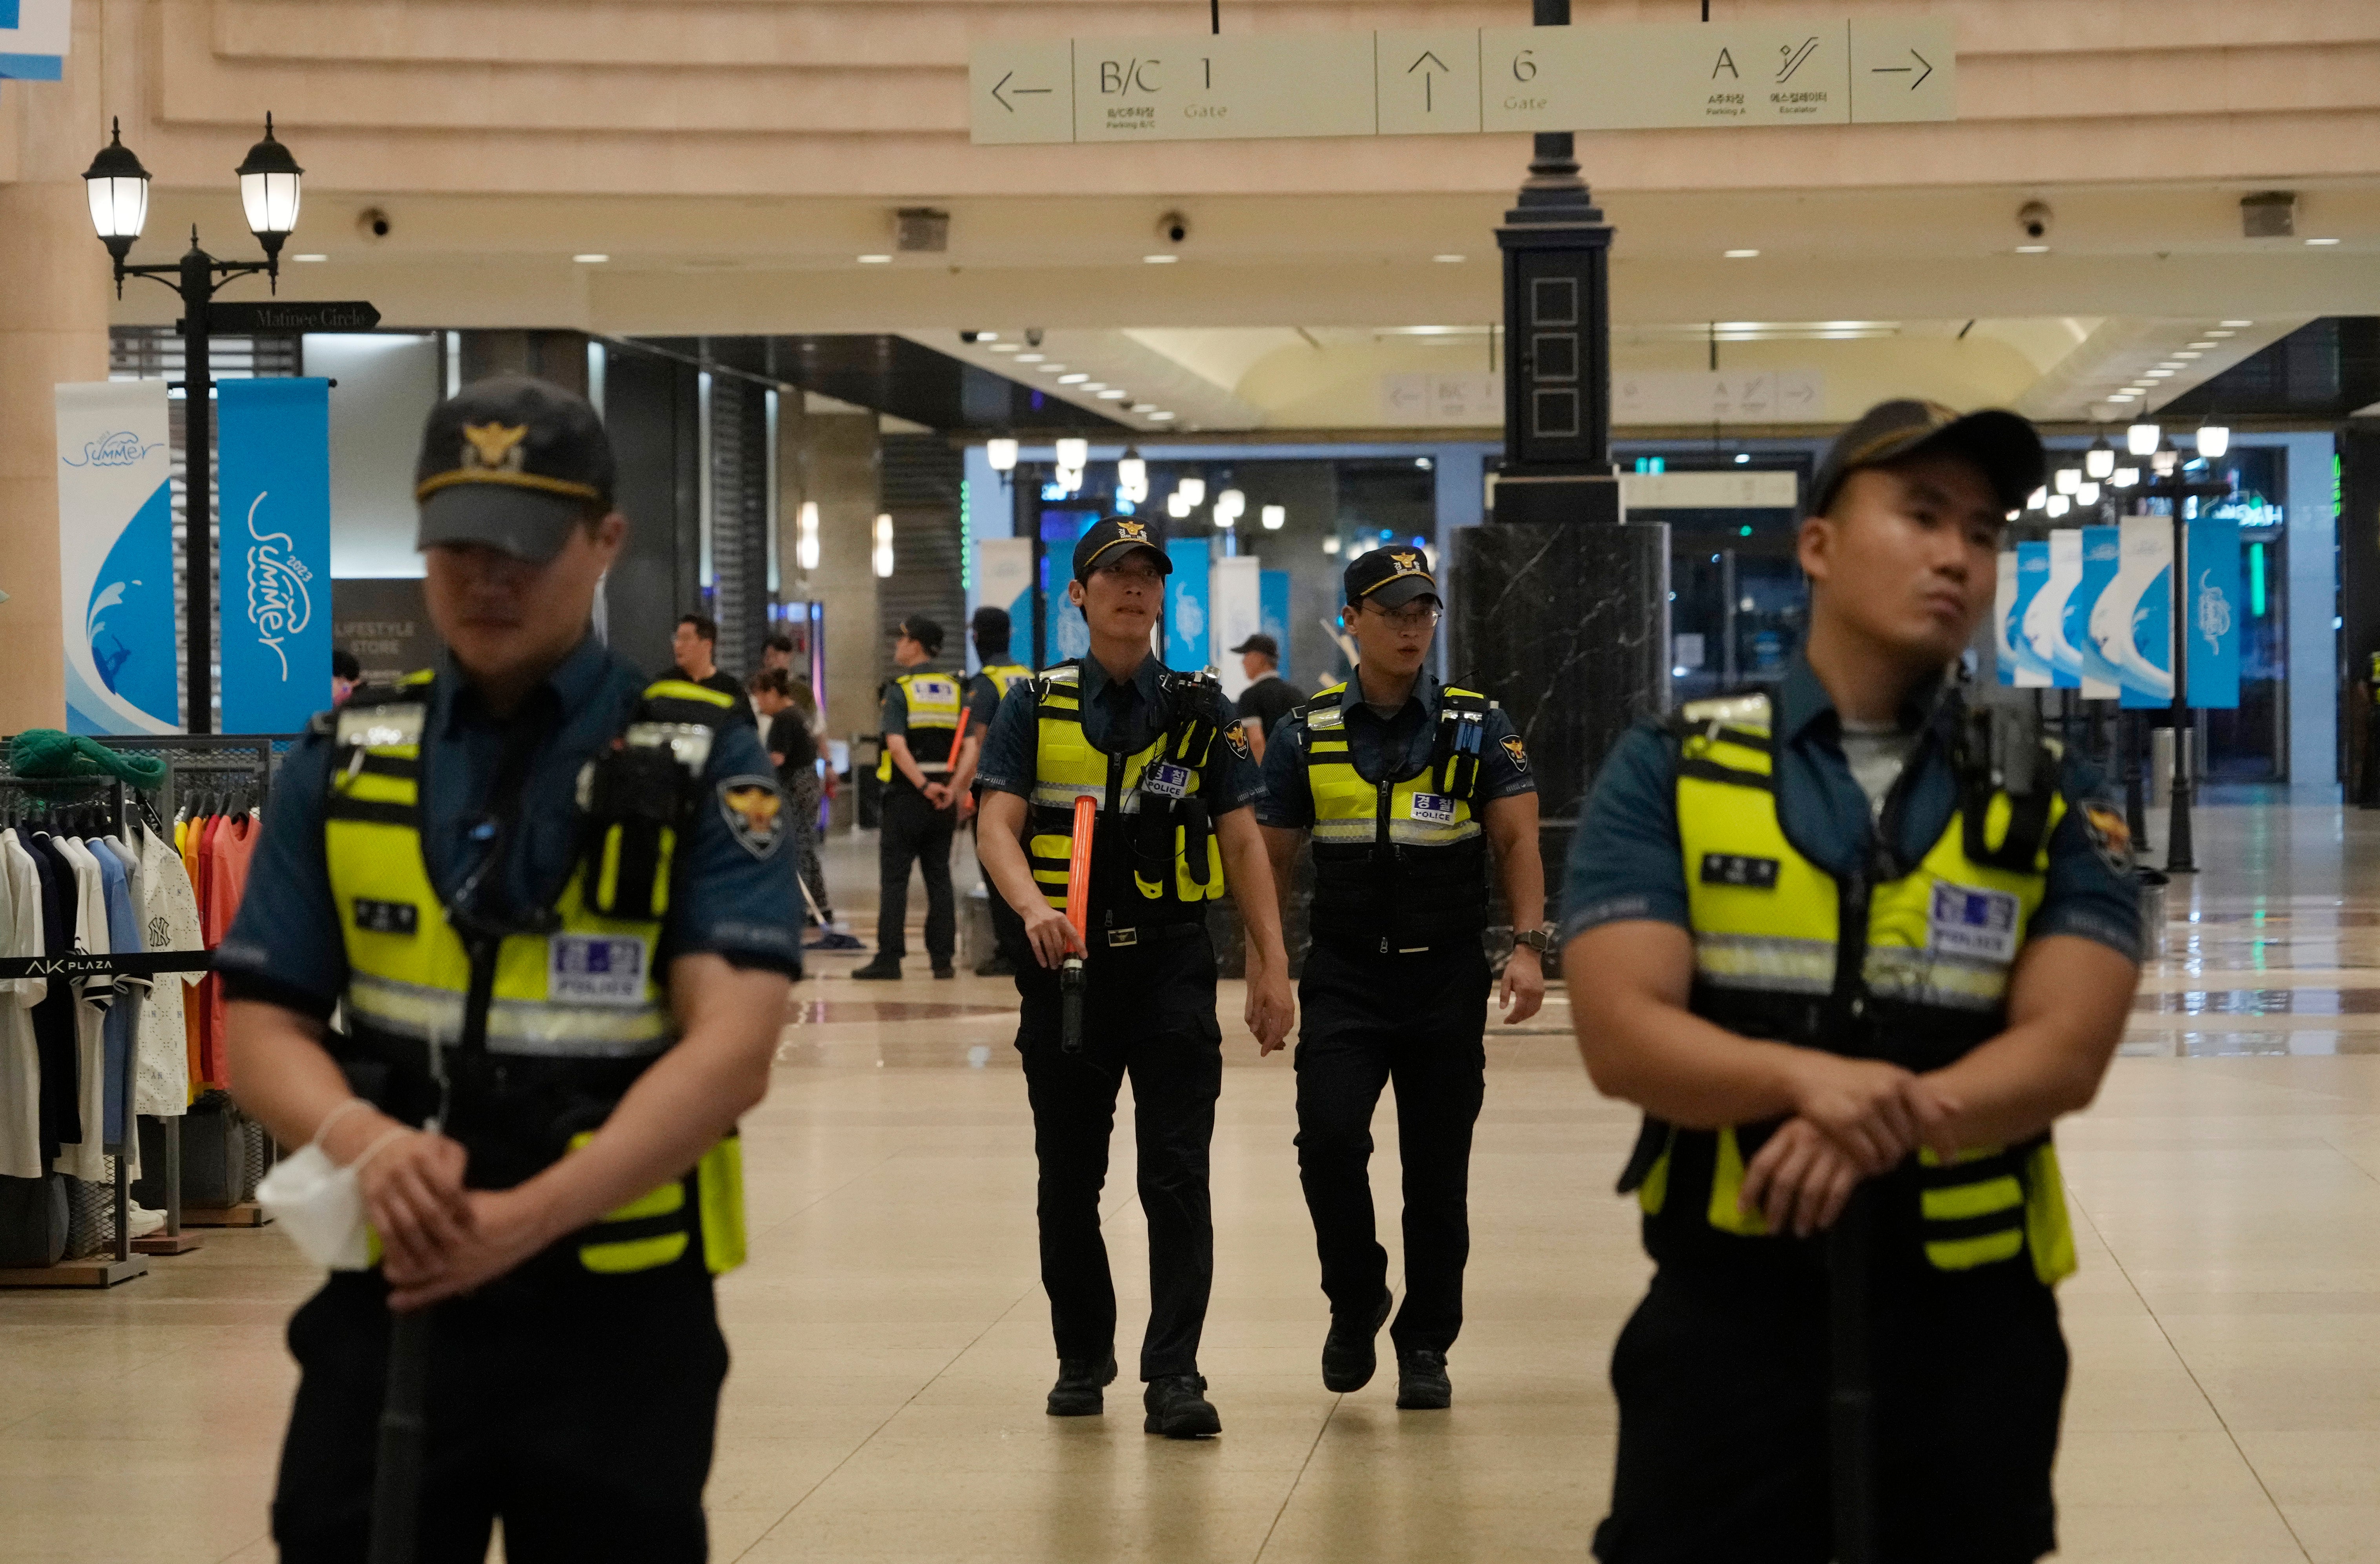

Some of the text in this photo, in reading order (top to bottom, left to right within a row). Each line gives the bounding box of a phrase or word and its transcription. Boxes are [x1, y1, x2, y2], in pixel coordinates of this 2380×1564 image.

[1513, 49, 1537, 82] 6
[1712, 47, 1739, 79] A
[1101, 58, 1210, 96] B/C 1
[1504, 96, 1547, 110] Gate
[1708, 93, 1745, 104] A주차장
[1184, 103, 1228, 118] Gate
[257, 308, 365, 326] Matinee Circle
[287, 555, 313, 582] 2023
[1148, 781, 1181, 796] POLICE
[1417, 796, 1452, 812] 경찰
[1416, 811, 1450, 821] POLICE
[25, 959, 113, 975] AK PLAZA
